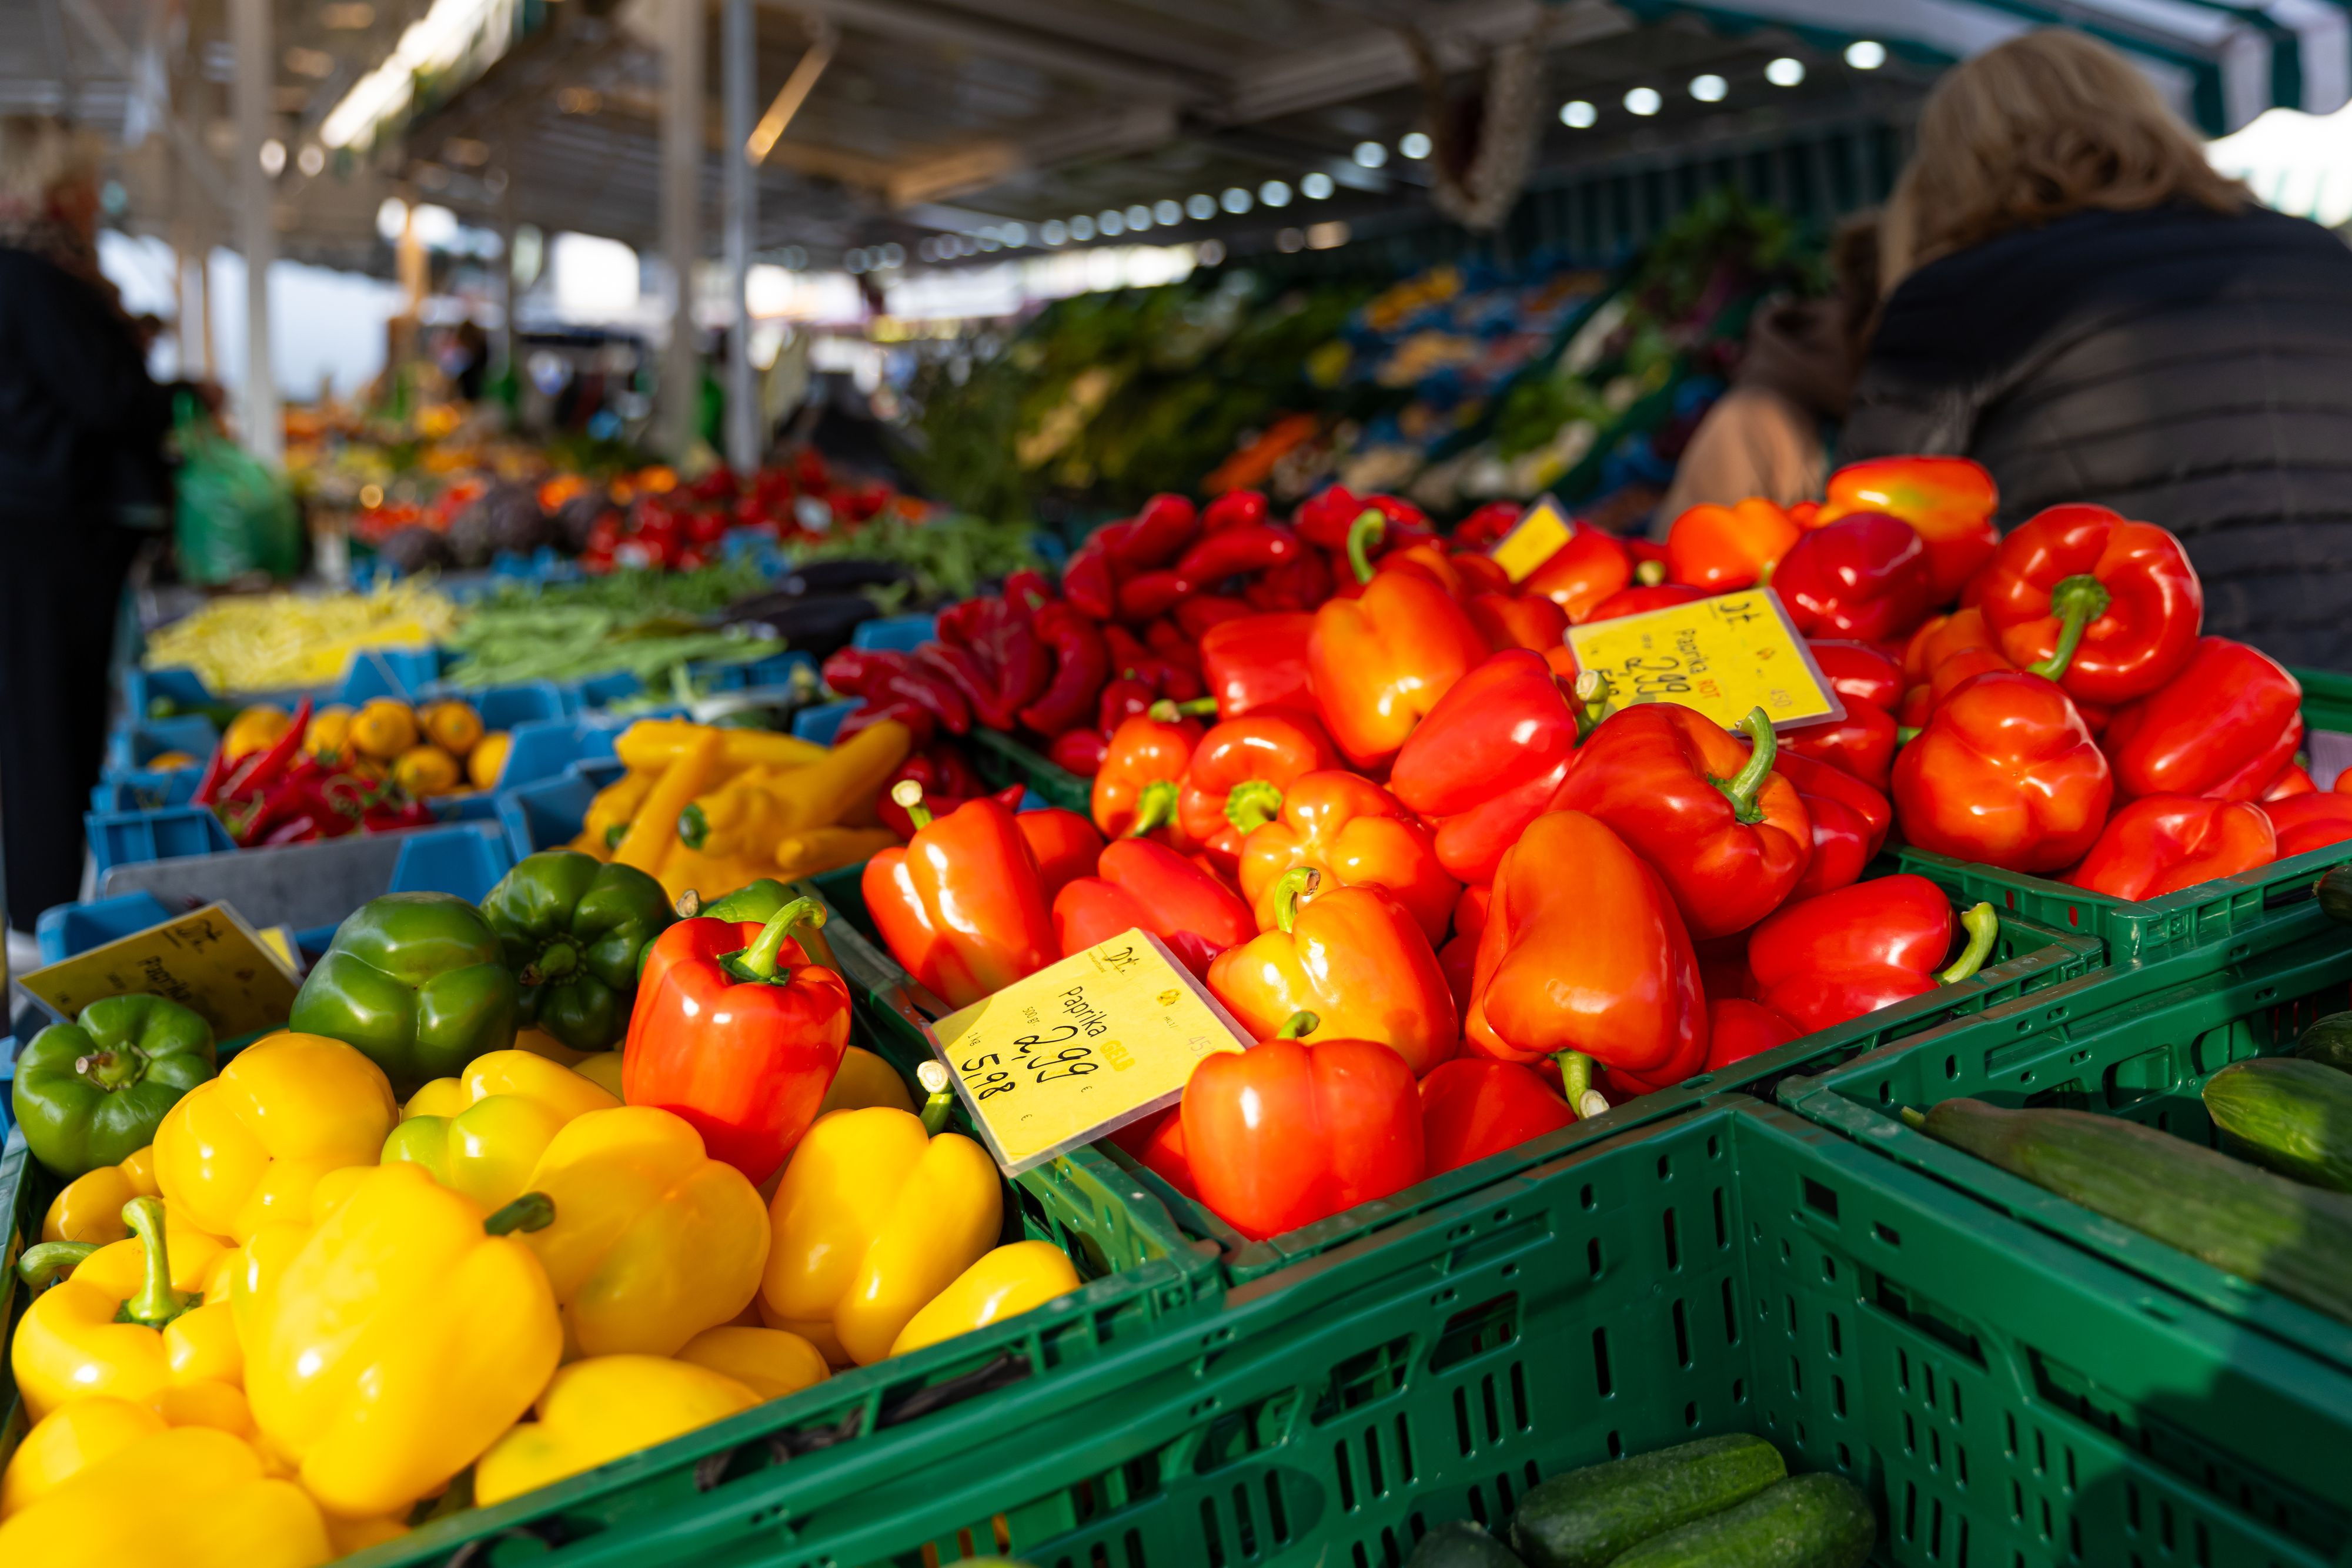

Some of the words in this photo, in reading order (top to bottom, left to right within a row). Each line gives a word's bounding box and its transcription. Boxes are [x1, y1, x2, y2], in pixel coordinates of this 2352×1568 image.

[1618, 656, 1692, 695] 2,99
[1675, 628, 1709, 674] Paprika
[1698, 679, 1720, 699] ROT
[1023, 1006, 1037, 1019] 500
[1058, 986, 1107, 1038] Paprika
[1100, 1039, 1135, 1072] GELB
[970, 1037, 981, 1047] kg
[1011, 1025, 1099, 1084] 2,99
[961, 1053, 1015, 1100] 5,98
